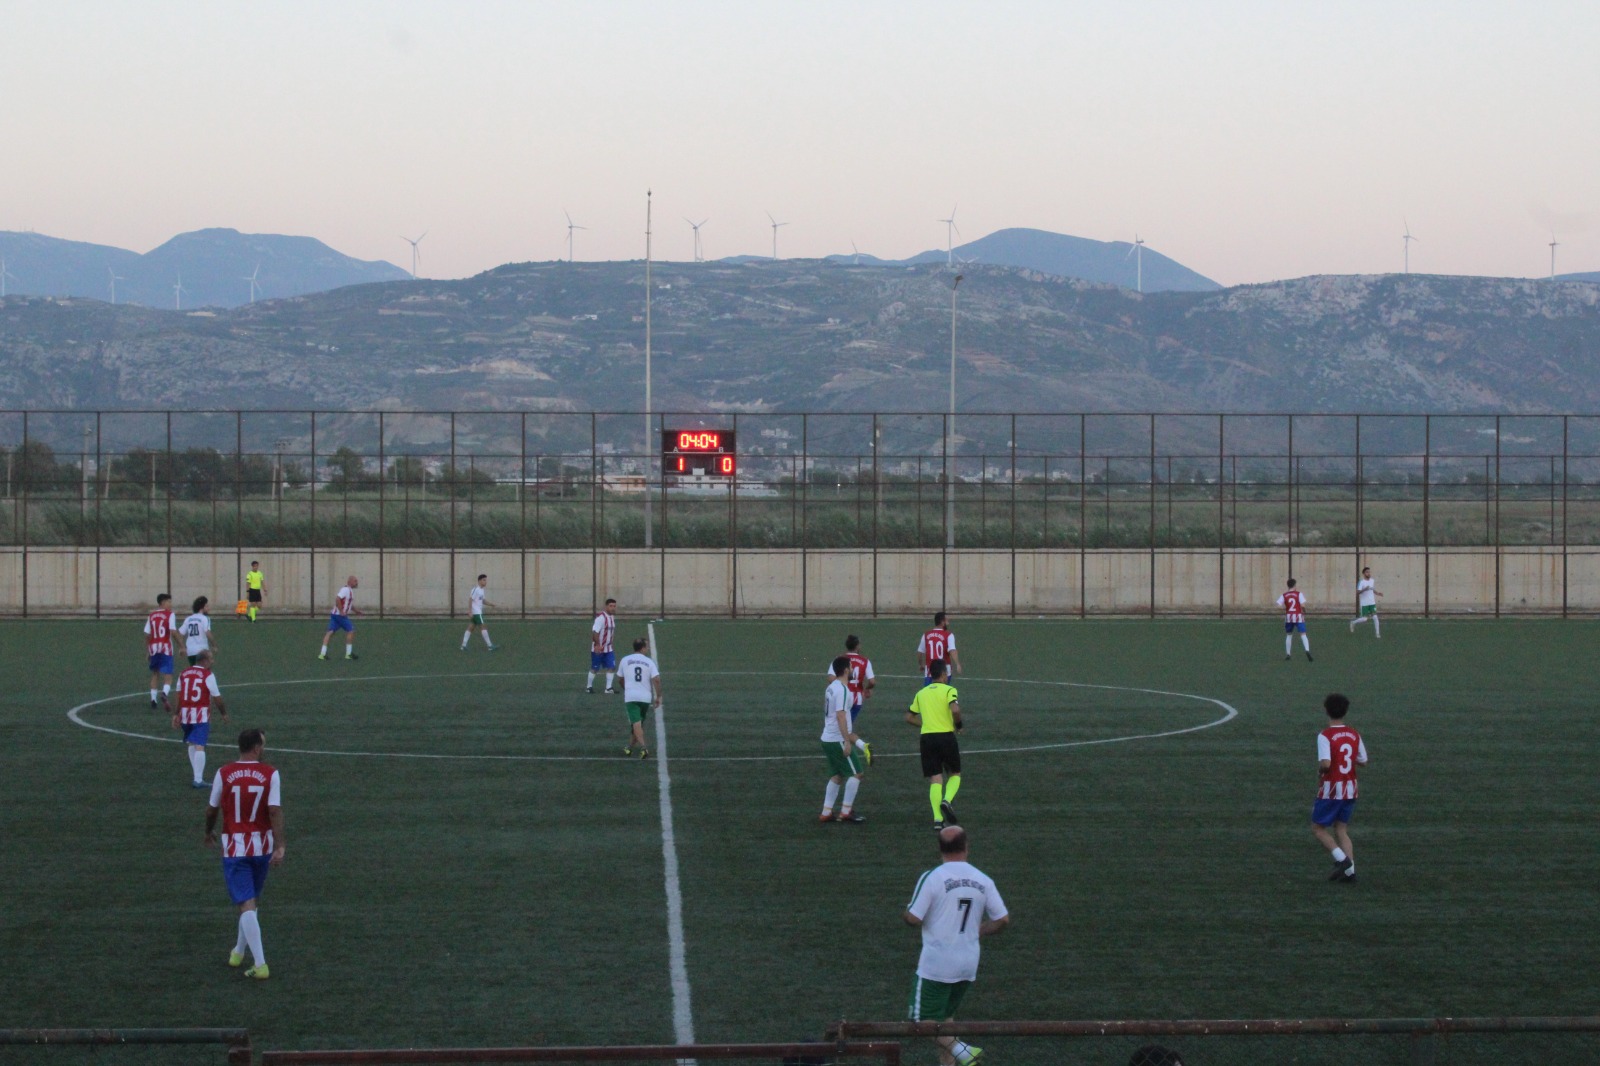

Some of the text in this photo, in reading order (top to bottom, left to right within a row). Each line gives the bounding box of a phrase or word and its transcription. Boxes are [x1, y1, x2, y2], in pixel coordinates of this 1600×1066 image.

[680, 433, 718, 448] 04:04
[679, 458, 684, 471] 1
[723, 457, 732, 472] 0
[1288, 597, 1297, 612] 2
[152, 620, 166, 639] 16
[188, 623, 200, 637] 20
[928, 640, 944, 660] 10
[634, 666, 642, 682] 8
[183, 677, 203, 702] 15
[1339, 743, 1353, 774] 3
[231, 785, 265, 823] 17
[958, 897, 973, 934] 7
